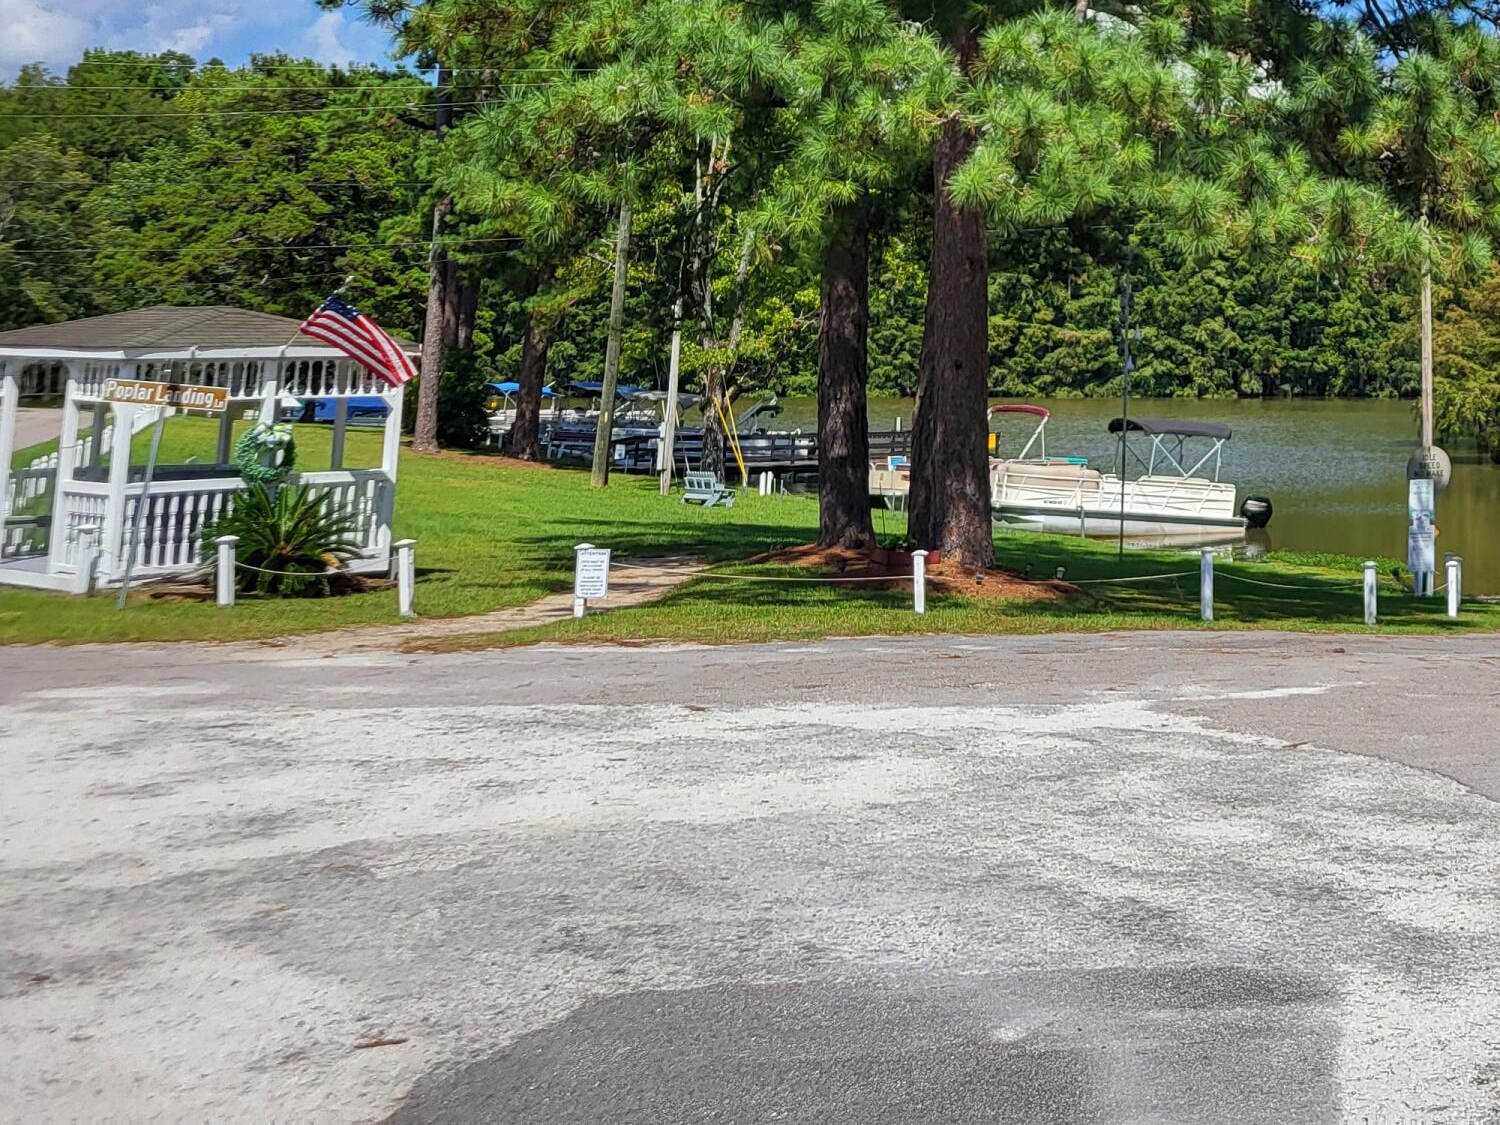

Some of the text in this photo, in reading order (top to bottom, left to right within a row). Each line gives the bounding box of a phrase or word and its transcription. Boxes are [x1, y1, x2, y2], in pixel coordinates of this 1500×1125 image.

[104, 380, 154, 400] Poplar
[154, 384, 215, 408] Landing
[1422, 453, 1437, 461] IDLE
[1418, 461, 1441, 470] SPEED
